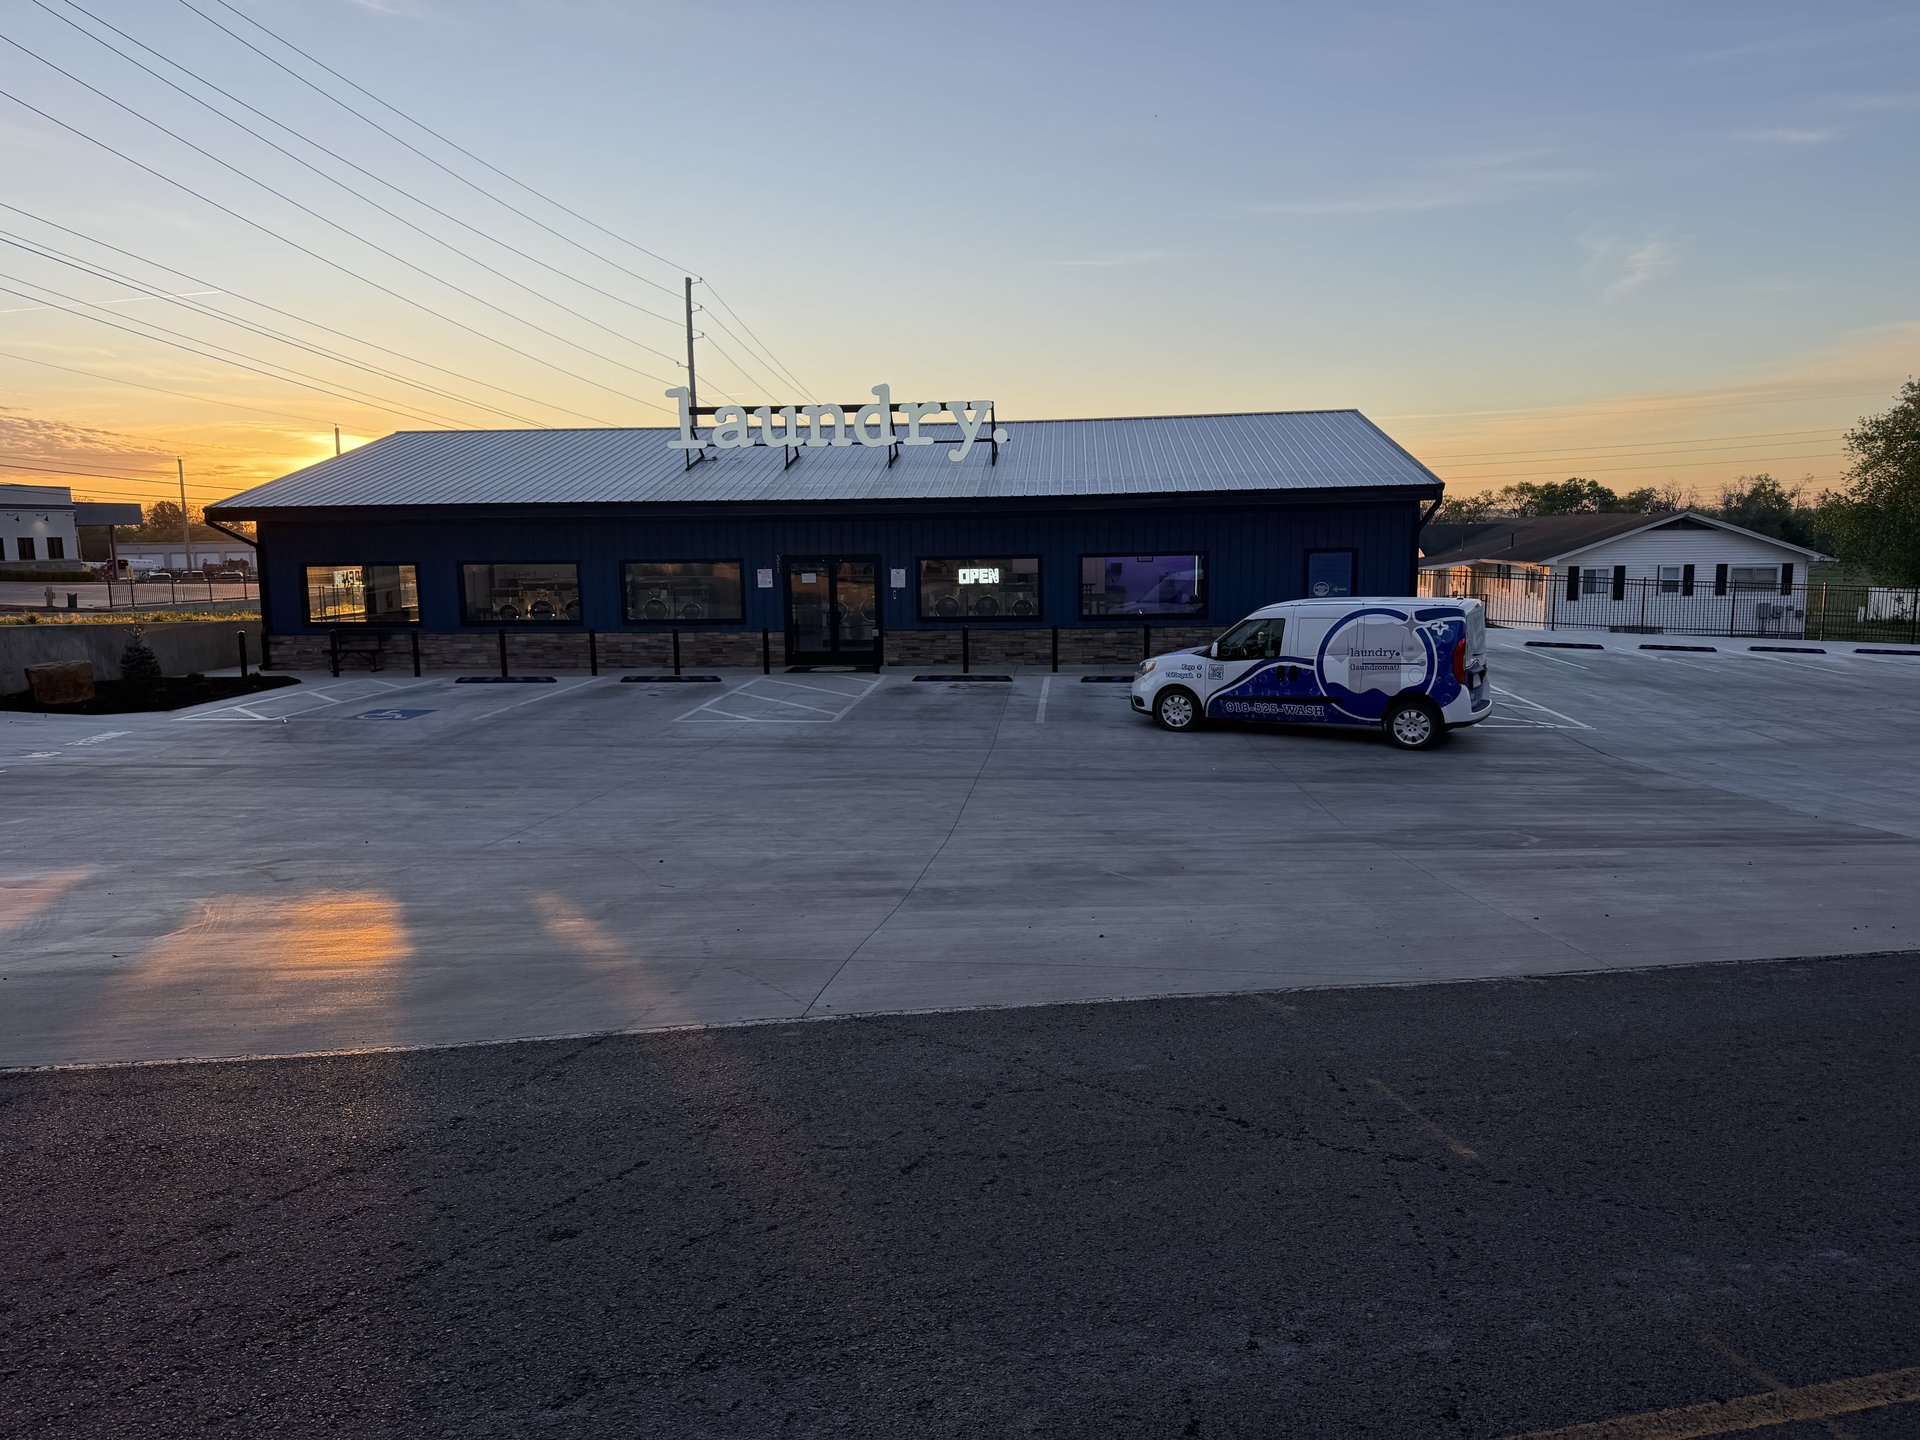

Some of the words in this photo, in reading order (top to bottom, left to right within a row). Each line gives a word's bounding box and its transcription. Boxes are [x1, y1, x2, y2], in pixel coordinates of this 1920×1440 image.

[665, 384, 1008, 461] laundry.
[958, 568, 999, 584] OPEN
[1350, 647, 1400, 659] laundry.
